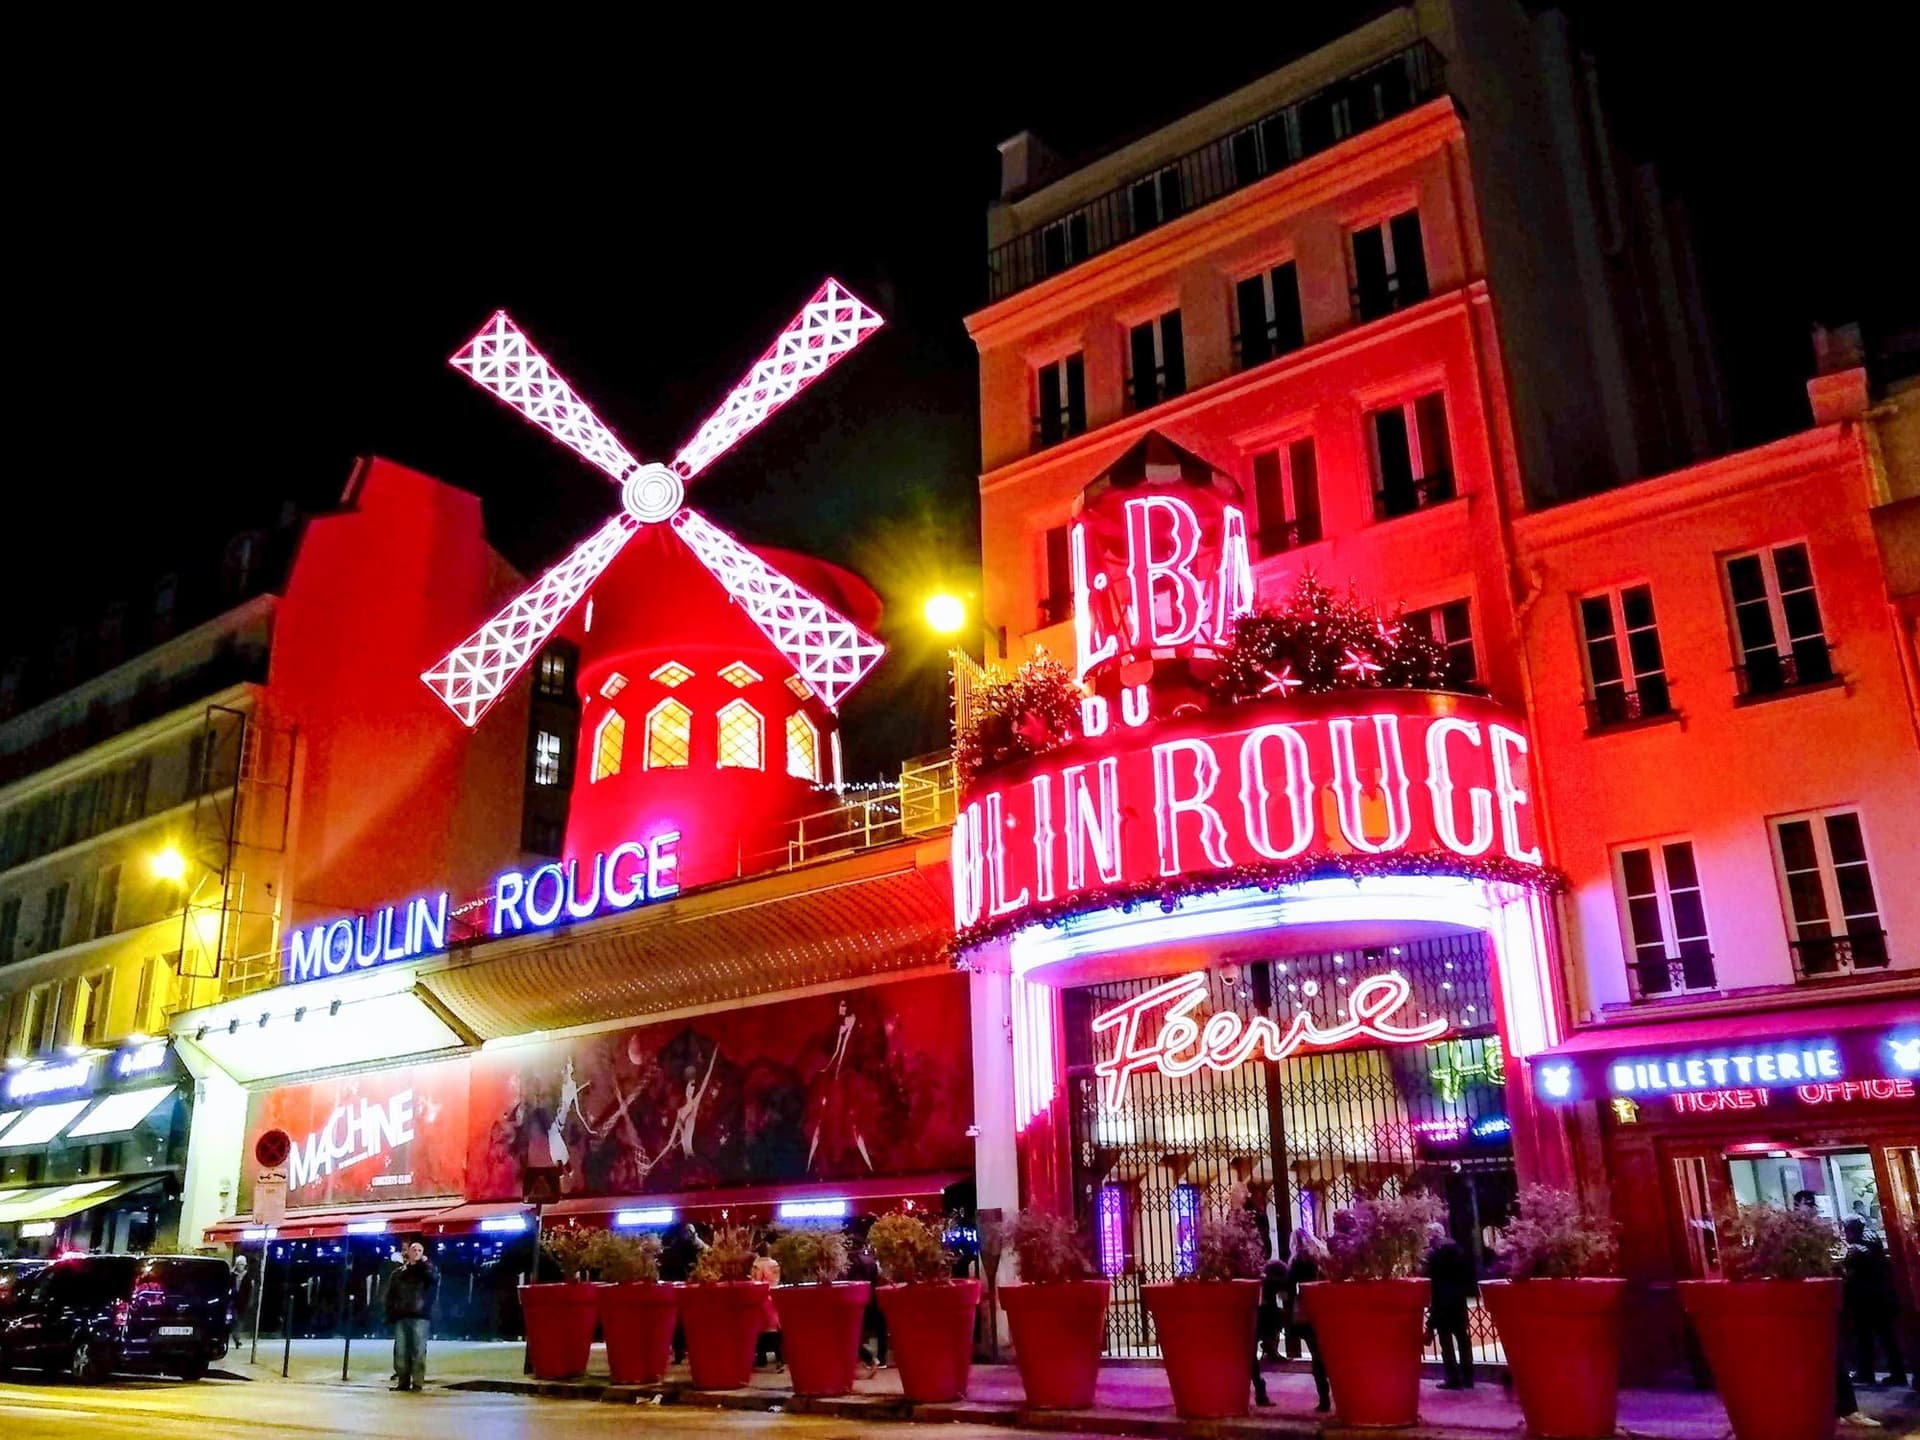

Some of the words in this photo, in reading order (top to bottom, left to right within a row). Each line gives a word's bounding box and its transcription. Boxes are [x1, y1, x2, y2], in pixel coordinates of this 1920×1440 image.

[1081, 684, 1150, 737] DU
[1152, 713, 1542, 877] ROUGE
[289, 891, 450, 982] MOULIN
[493, 830, 682, 934] ROUGE
[1614, 1049, 1840, 1091] BILLETTERIE
[1670, 1087, 1770, 1113] TICKET
[1797, 1078, 1916, 1104] OFFICE
[288, 1088, 415, 1191] MACHINE
